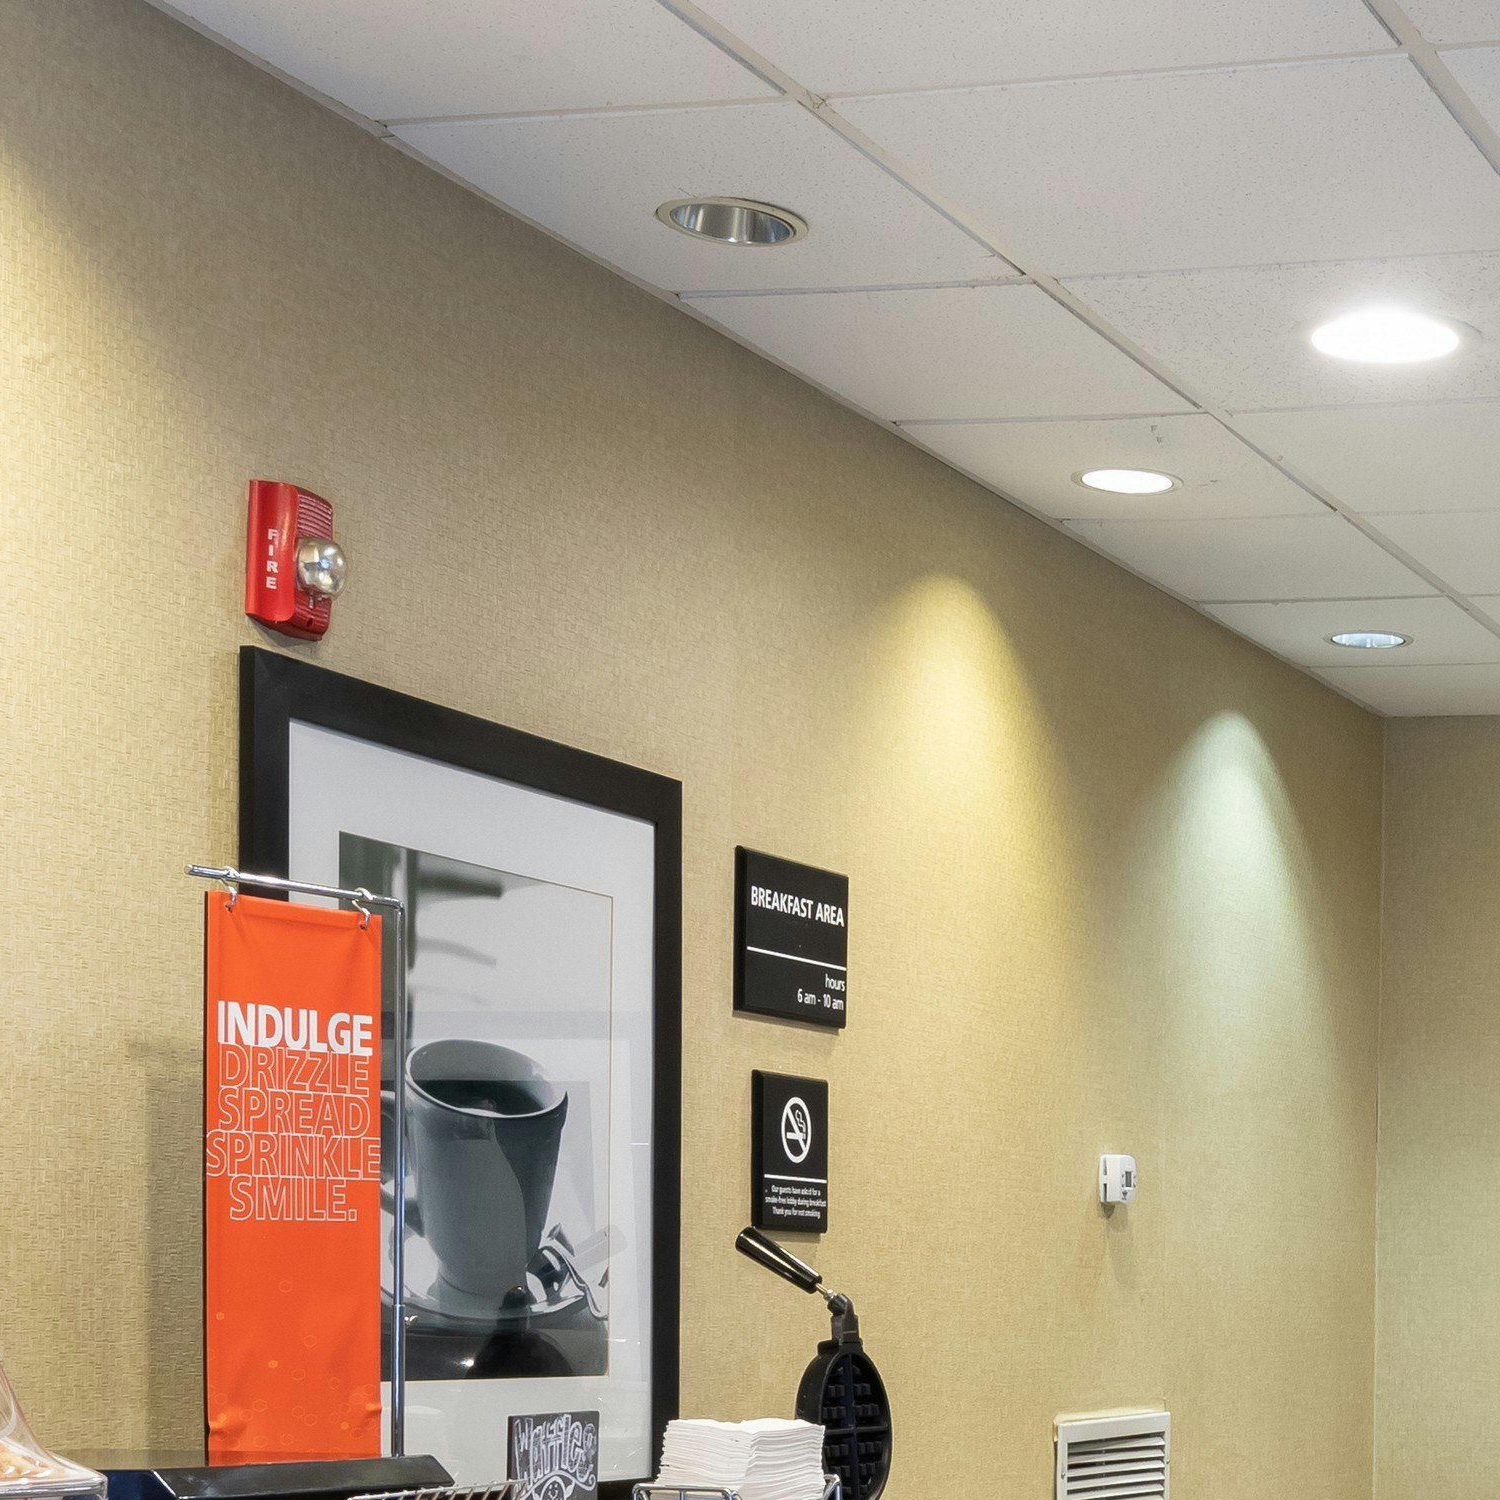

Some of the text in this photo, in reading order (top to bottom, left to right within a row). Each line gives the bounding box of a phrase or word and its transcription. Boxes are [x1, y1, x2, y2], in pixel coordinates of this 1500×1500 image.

[266, 528, 279, 590] FIRE
[751, 885, 845, 927] BREAKFAST AREA
[797, 988, 803, 1002] 6
[804, 993, 816, 1005] am
[823, 994, 831, 1008] 10
[832, 998, 844, 1010] am
[825, 973, 845, 991] hours
[217, 1000, 373, 1056] INDULGE
[219, 1042, 370, 1097] DRIZZLE
[218, 1085, 371, 1138] SPREAD
[206, 1128, 381, 1181] SPRINKLE
[229, 1173, 357, 1222] SMILE.
